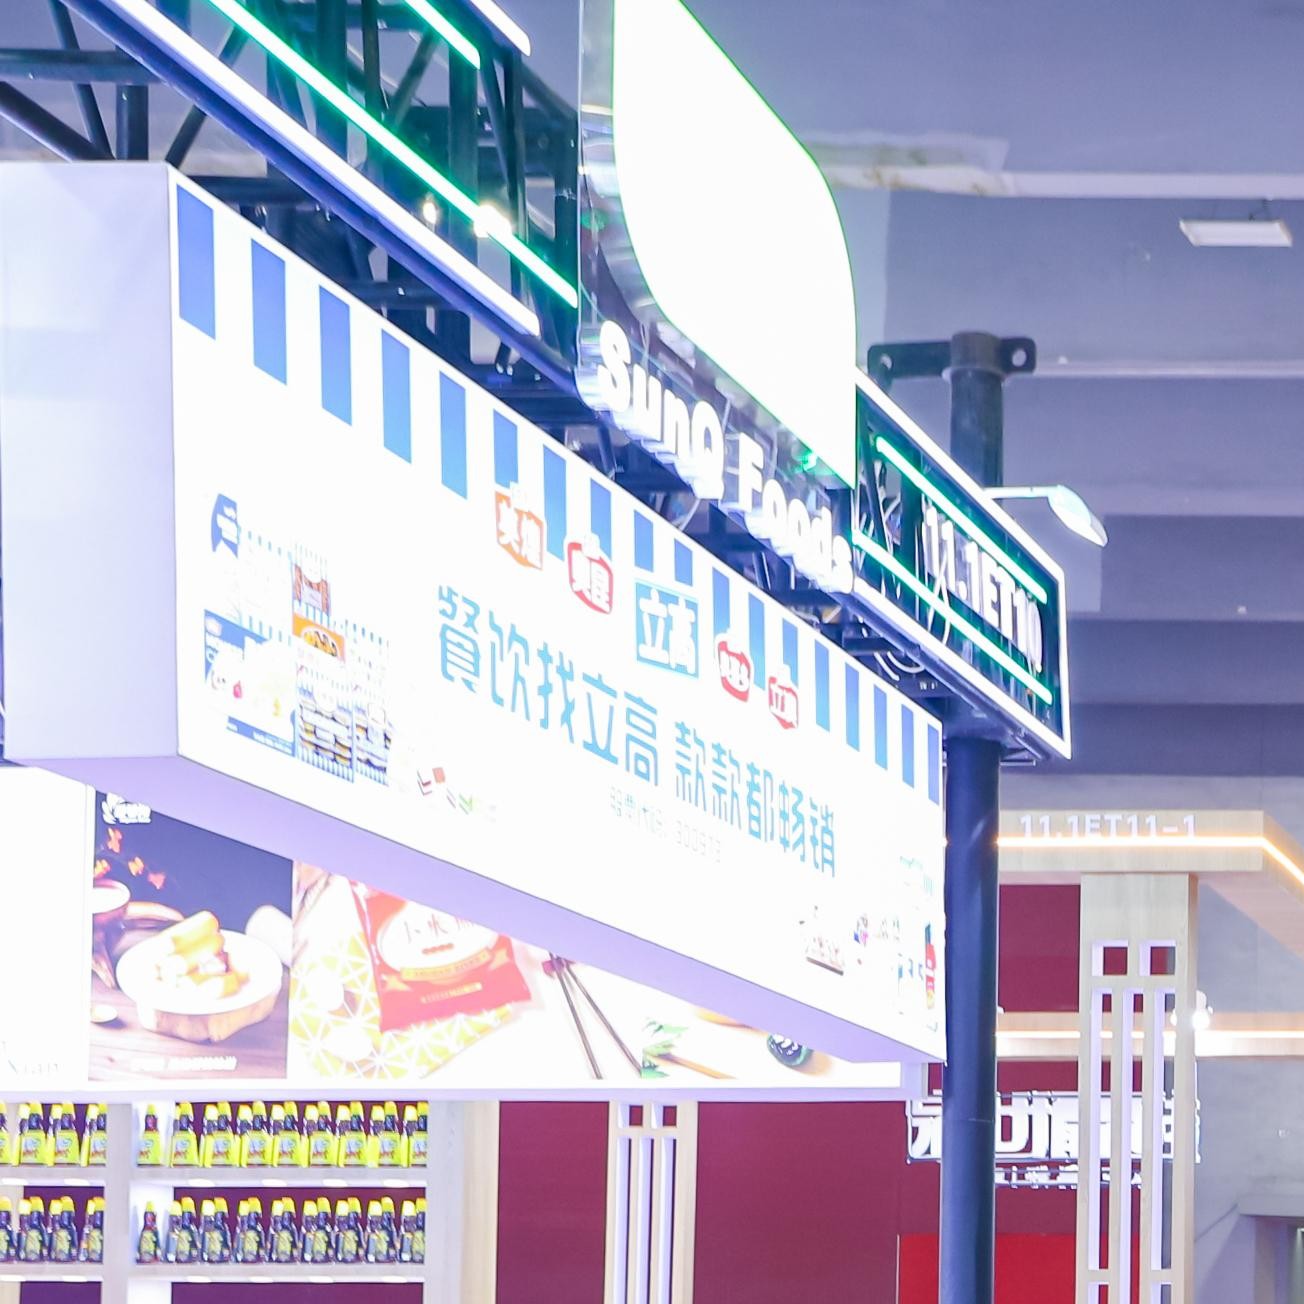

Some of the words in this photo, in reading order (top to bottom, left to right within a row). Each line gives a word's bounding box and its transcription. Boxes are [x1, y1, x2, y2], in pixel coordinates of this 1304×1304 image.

[598, 320, 726, 499] SunQ
[737, 431, 854, 594] Foods
[438, 586, 659, 788] 餐饮找立高
[675, 721, 836, 878] 款款都畅销
[639, 588, 697, 675] 立高
